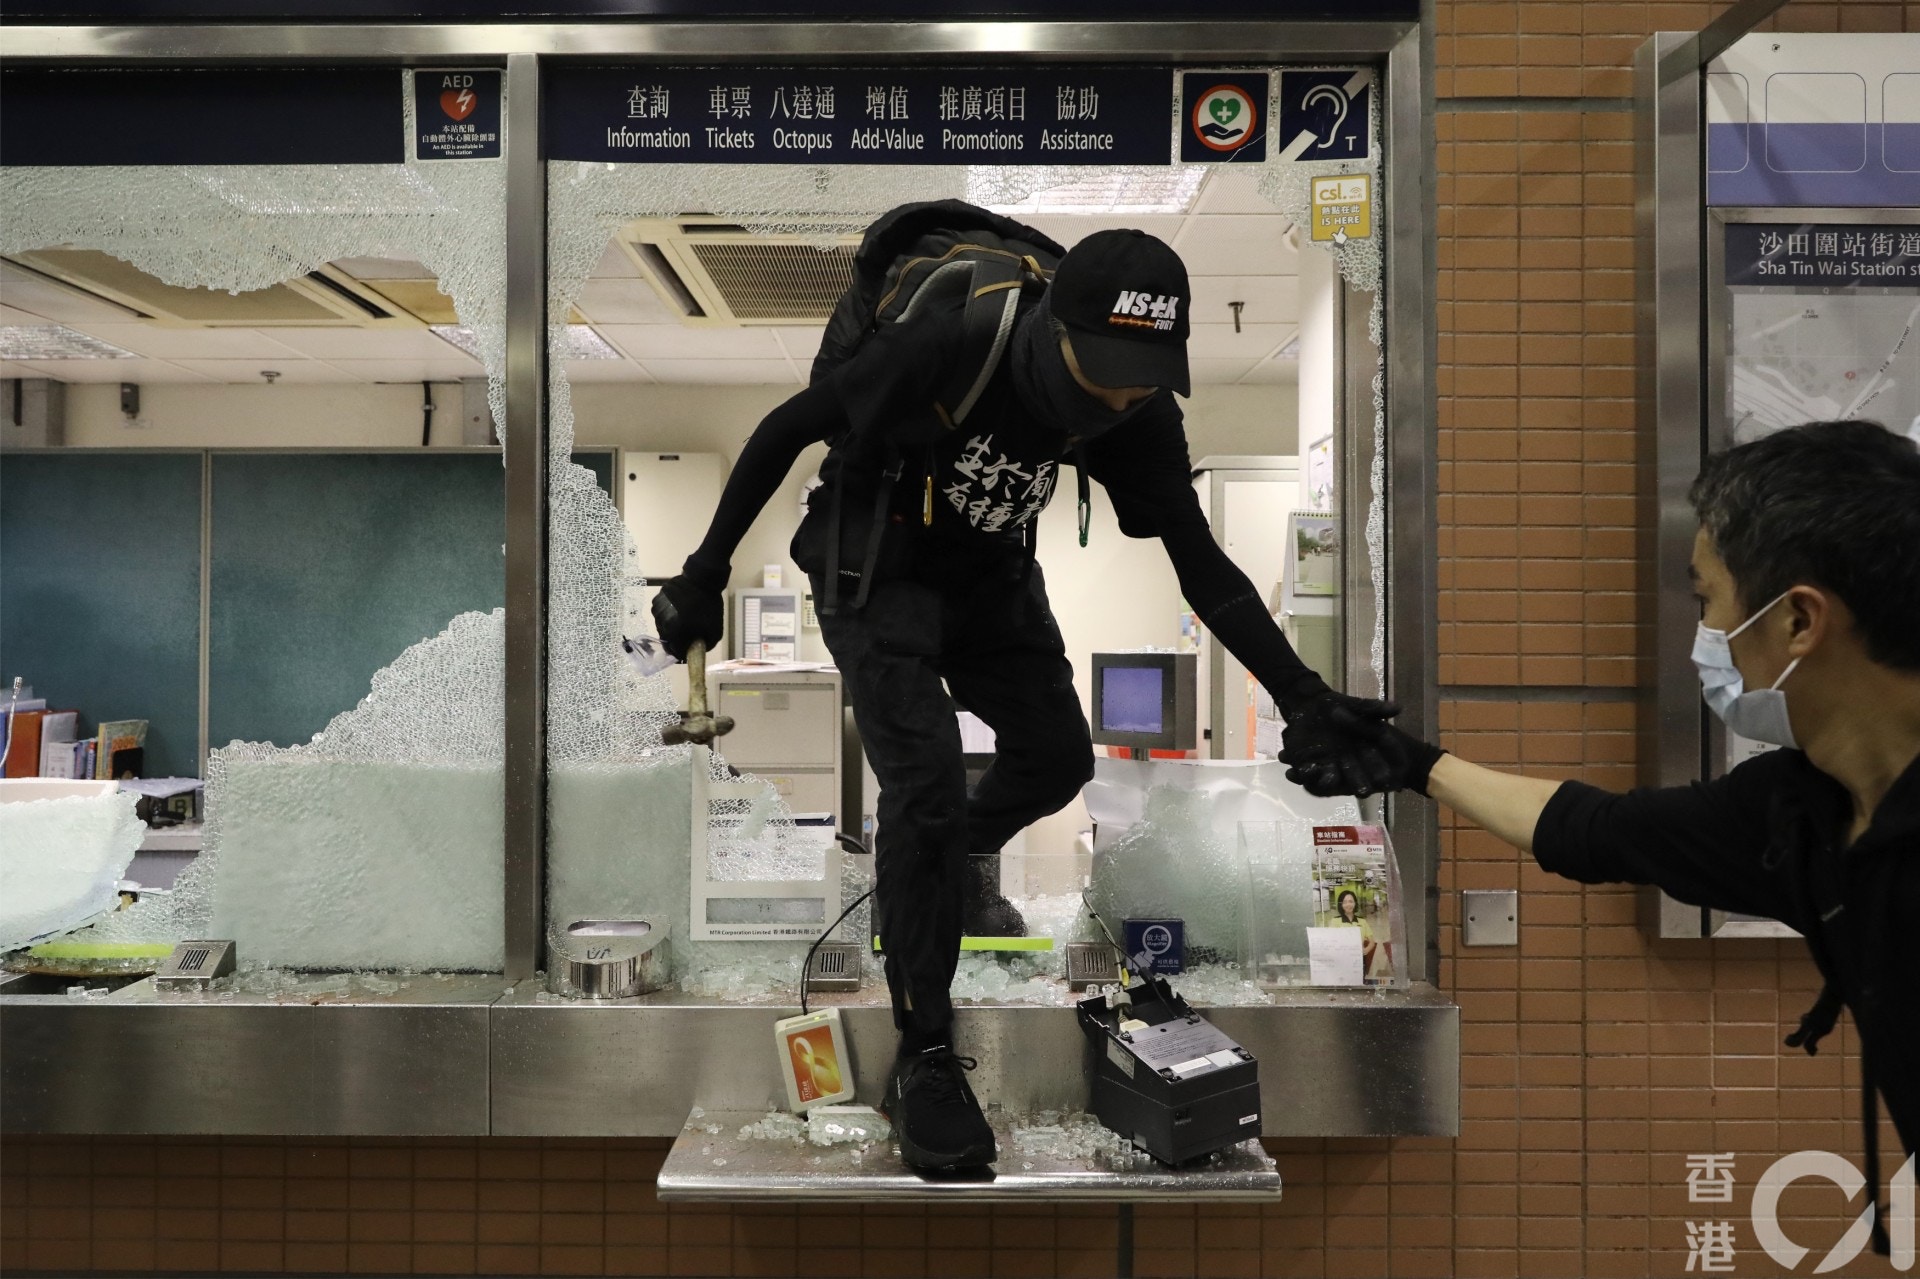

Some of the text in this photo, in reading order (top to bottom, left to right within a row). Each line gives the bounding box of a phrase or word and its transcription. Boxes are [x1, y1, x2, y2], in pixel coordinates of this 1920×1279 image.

[442, 75, 473, 88] AED
[627, 85, 1099, 121] 查詢 車票 八達通 增值 推廣項目 協助
[442, 124, 476, 133] 本站配備
[422, 133, 496, 143] 自動體外心臟除顫器
[607, 126, 1114, 154] Information Tickets Octopus Add-Value Promotions Assistance
[1345, 135, 1357, 151] T
[1321, 215, 1360, 226] IS HERE
[1759, 231, 1920, 257] 沙田圍站街道
[1758, 260, 1786, 275] Sha
[1790, 260, 1814, 275] Tin
[1818, 261, 1847, 275] Wai
[1851, 261, 1906, 276] Station
[773, 928, 823, 936] 香港鐵路有限公司
[1146, 934, 1168, 942] 放大鏡
